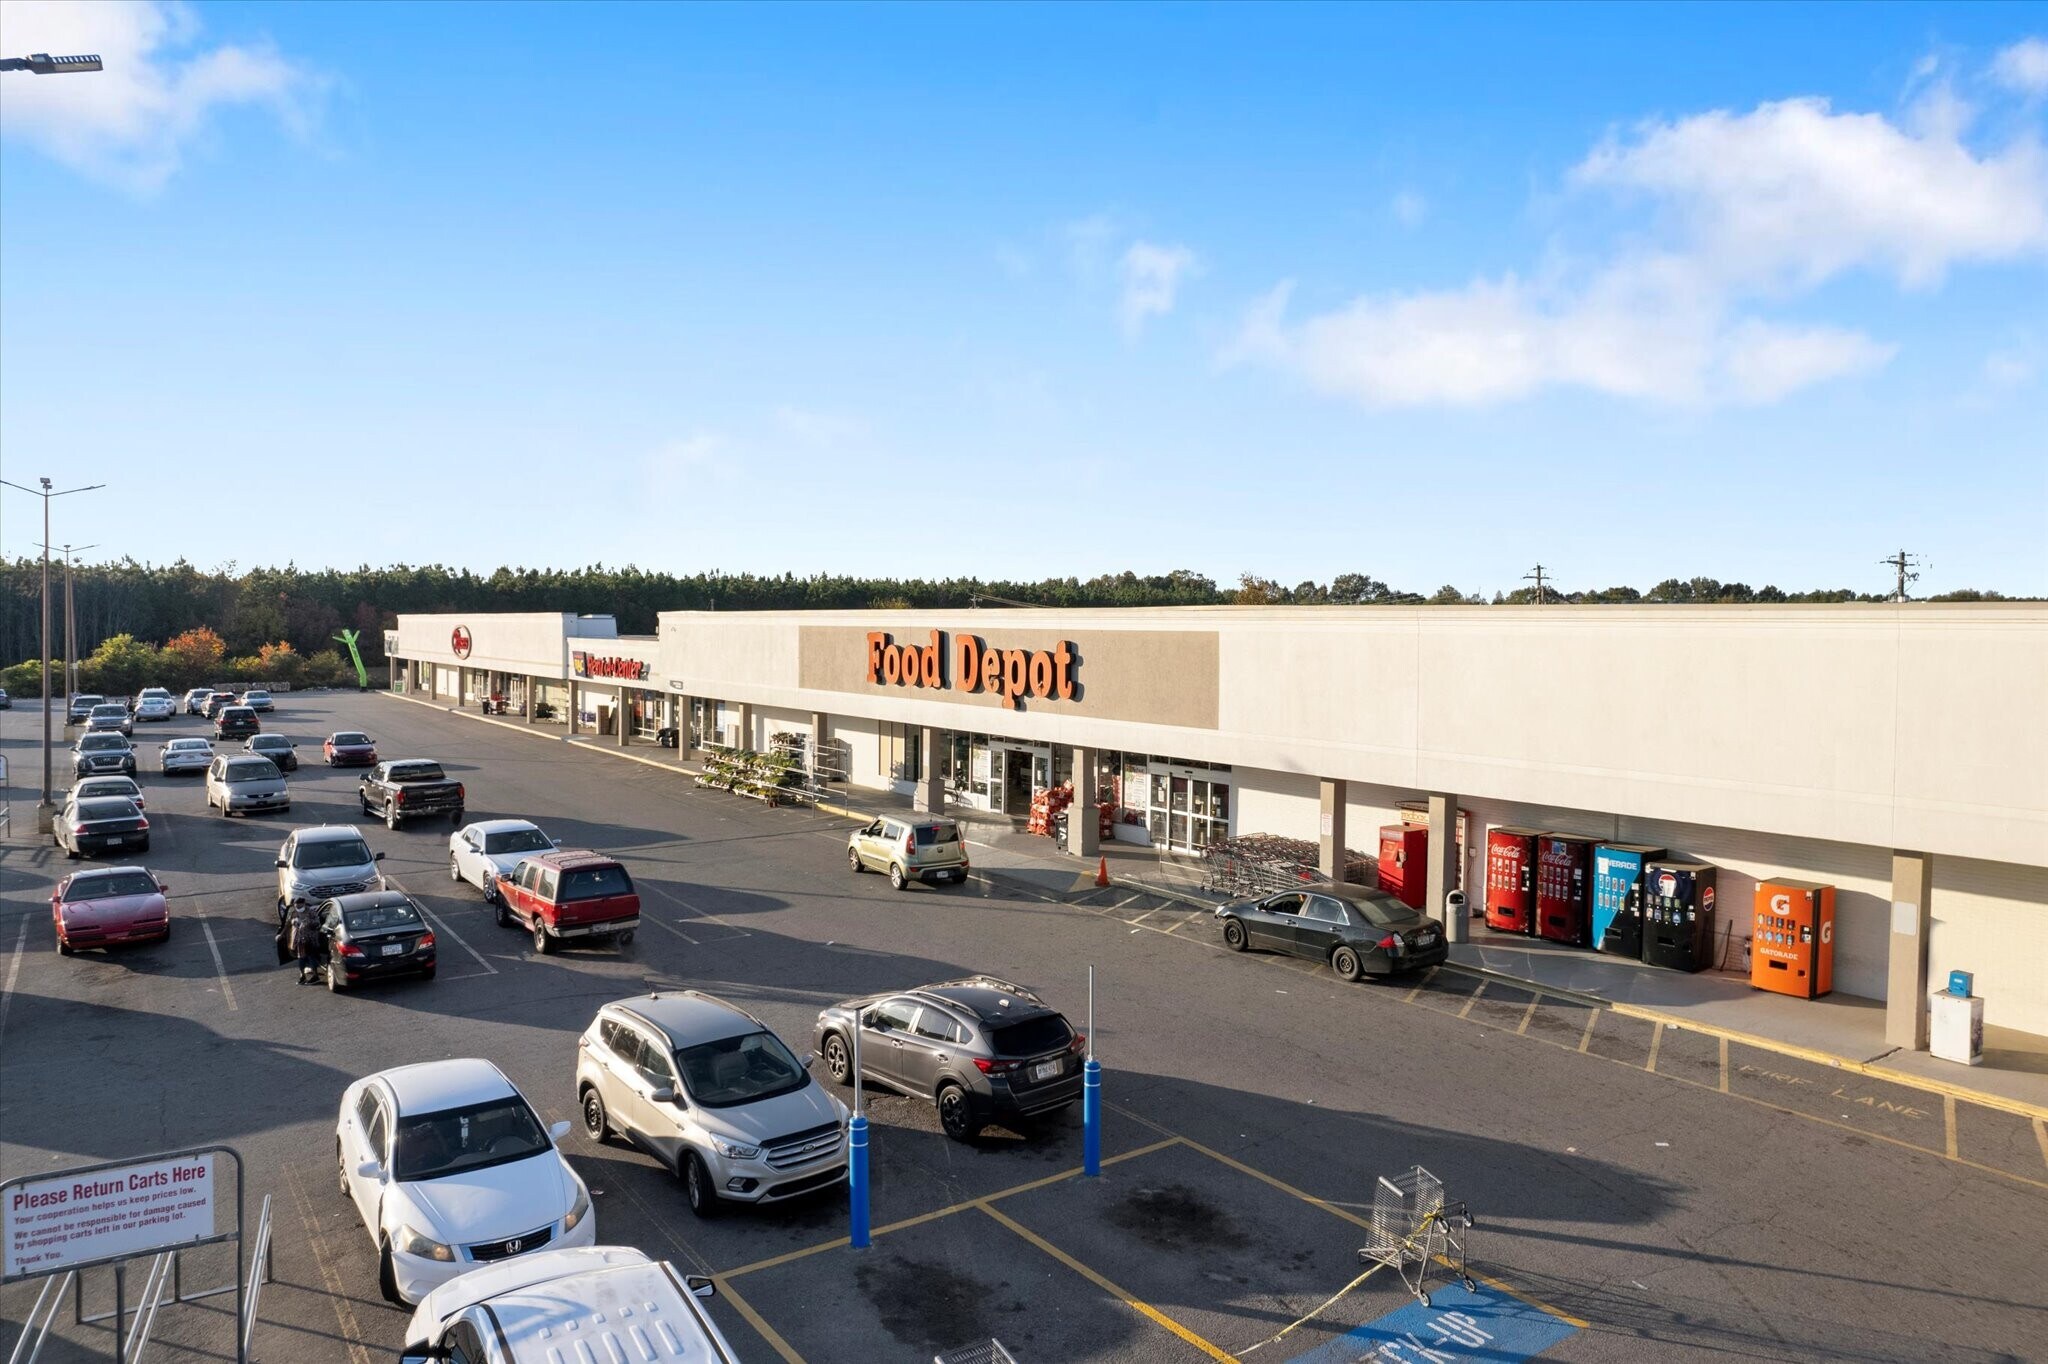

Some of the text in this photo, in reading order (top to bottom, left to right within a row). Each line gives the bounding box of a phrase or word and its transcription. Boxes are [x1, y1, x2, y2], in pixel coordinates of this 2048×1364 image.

[866, 628, 1075, 710] Food Depot
[1760, 947, 1799, 960] GATORADE
[13, 1166, 206, 1211] Please Return Carts Here
[14, 1216, 34, 1225] Your
[36, 1205, 90, 1221] cooperation
[92, 1200, 116, 1211] helps
[129, 1195, 150, 1204] keep
[152, 1189, 178, 1202] prices
[179, 1186, 197, 1195] low.
[14, 1197, 206, 1240] We cannot be responsible for damage caused
[14, 1212, 186, 1250] by shopping carts left in our parking lot.
[15, 1251, 64, 1266] Thank You.
